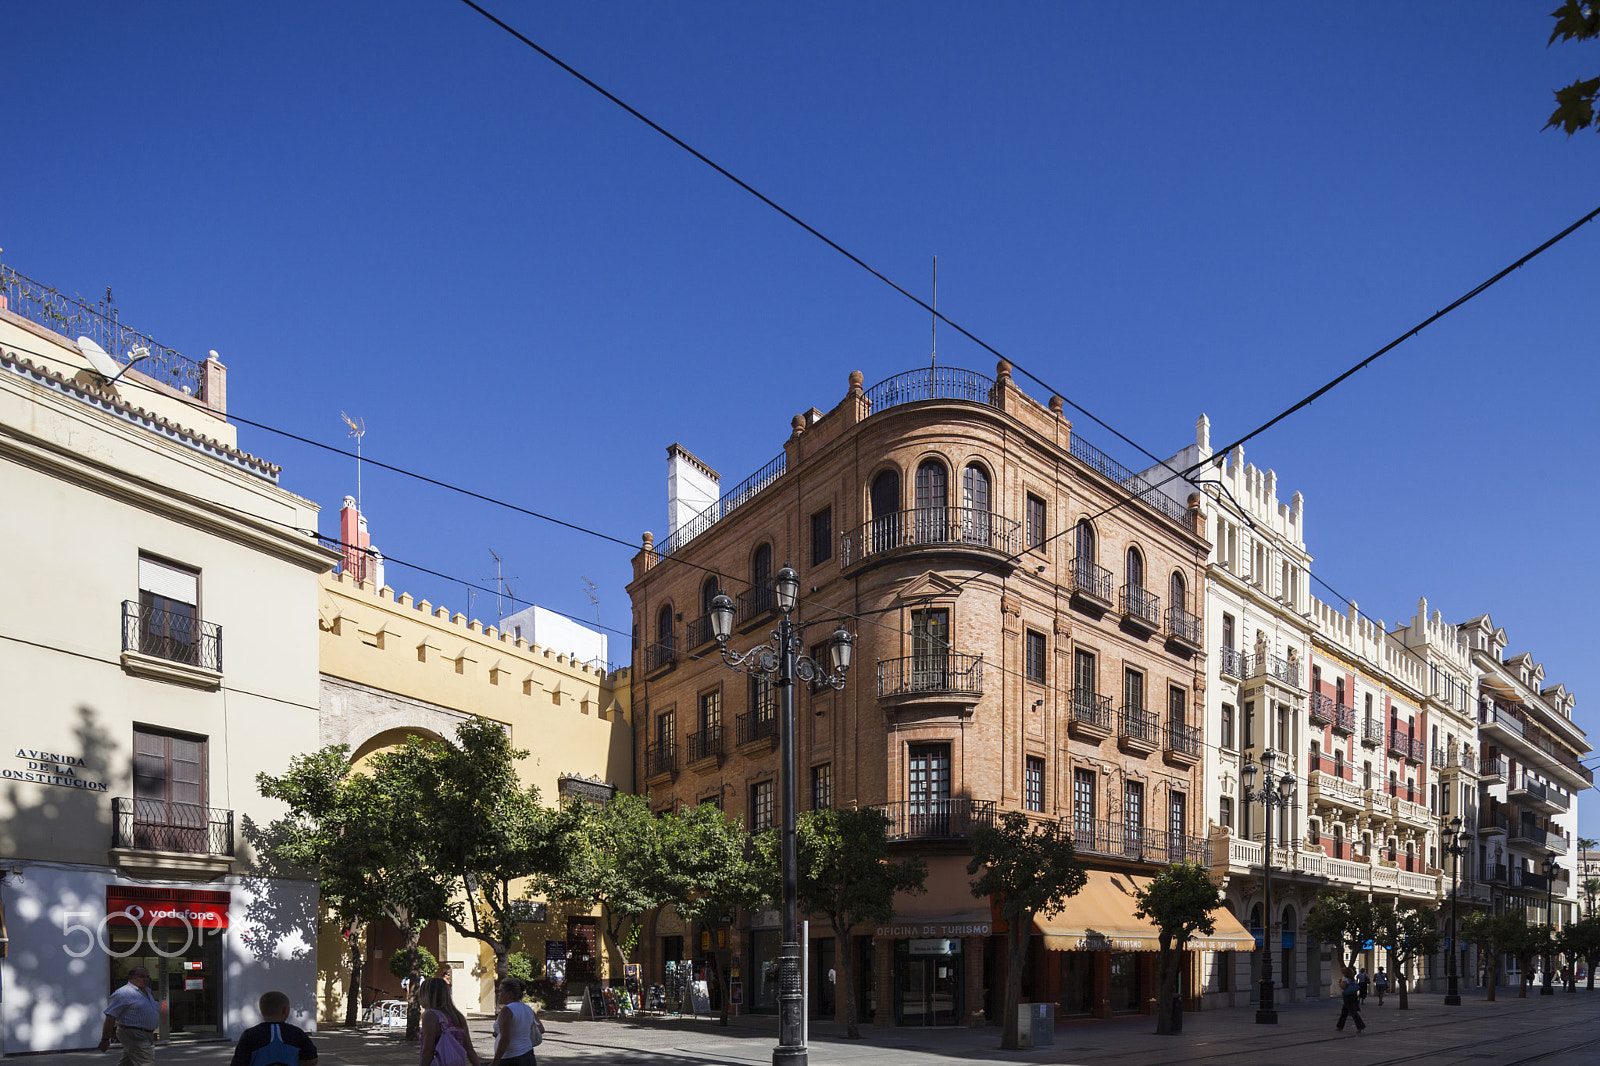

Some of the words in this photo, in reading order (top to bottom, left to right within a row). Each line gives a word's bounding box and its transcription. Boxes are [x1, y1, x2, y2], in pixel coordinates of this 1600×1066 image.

[17, 748, 86, 766] AVENIDA
[28, 761, 49, 771] DE
[55, 765, 75, 776] LA
[0, 769, 108, 791] ONSTITUCION
[149, 908, 214, 921] vodafone
[876, 927, 918, 936] OFICINA
[941, 926, 989, 934] TURISMO
[1115, 940, 1142, 948] TURISMO
